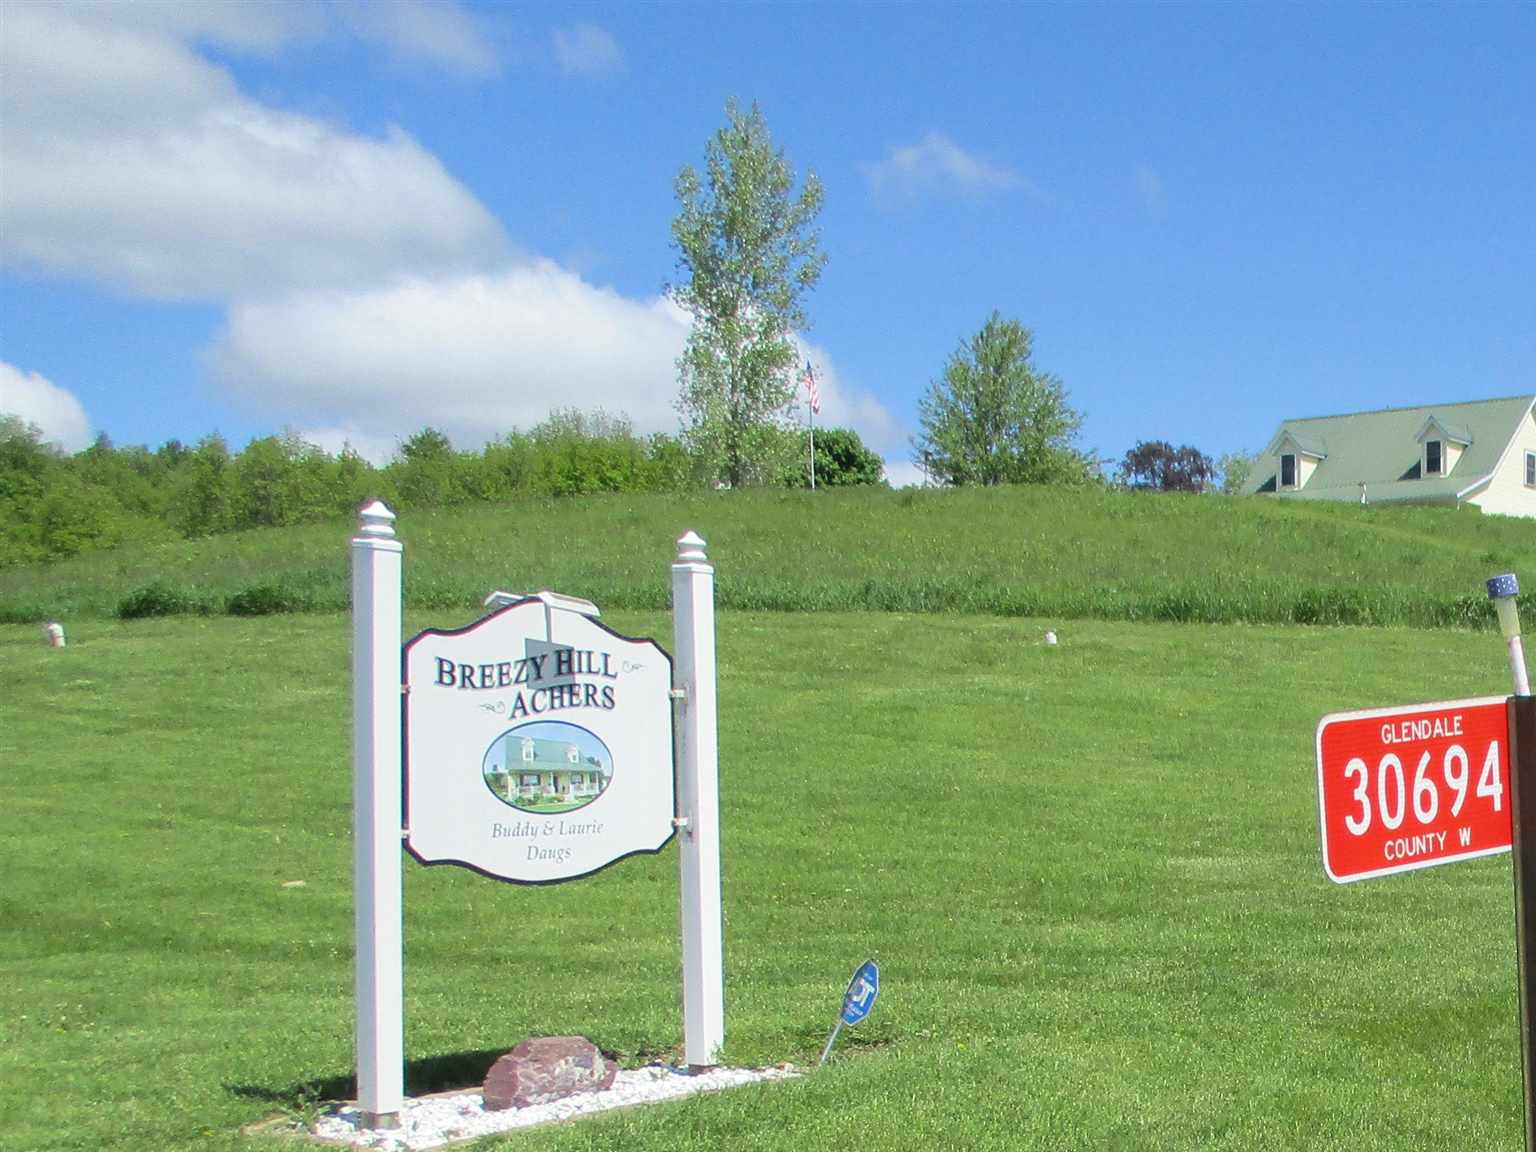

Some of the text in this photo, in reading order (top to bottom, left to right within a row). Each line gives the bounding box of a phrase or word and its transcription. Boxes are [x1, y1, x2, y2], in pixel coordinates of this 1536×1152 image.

[434, 649, 618, 690] BREEZY HILL
[508, 683, 616, 720] ACHERS
[1381, 715, 1463, 744] GLENDALE
[1344, 739, 1504, 836] 30694
[492, 819, 604, 842] Buddy & Laurie
[1384, 827, 1471, 860] COUNTY W
[527, 845, 572, 864] Daugs
